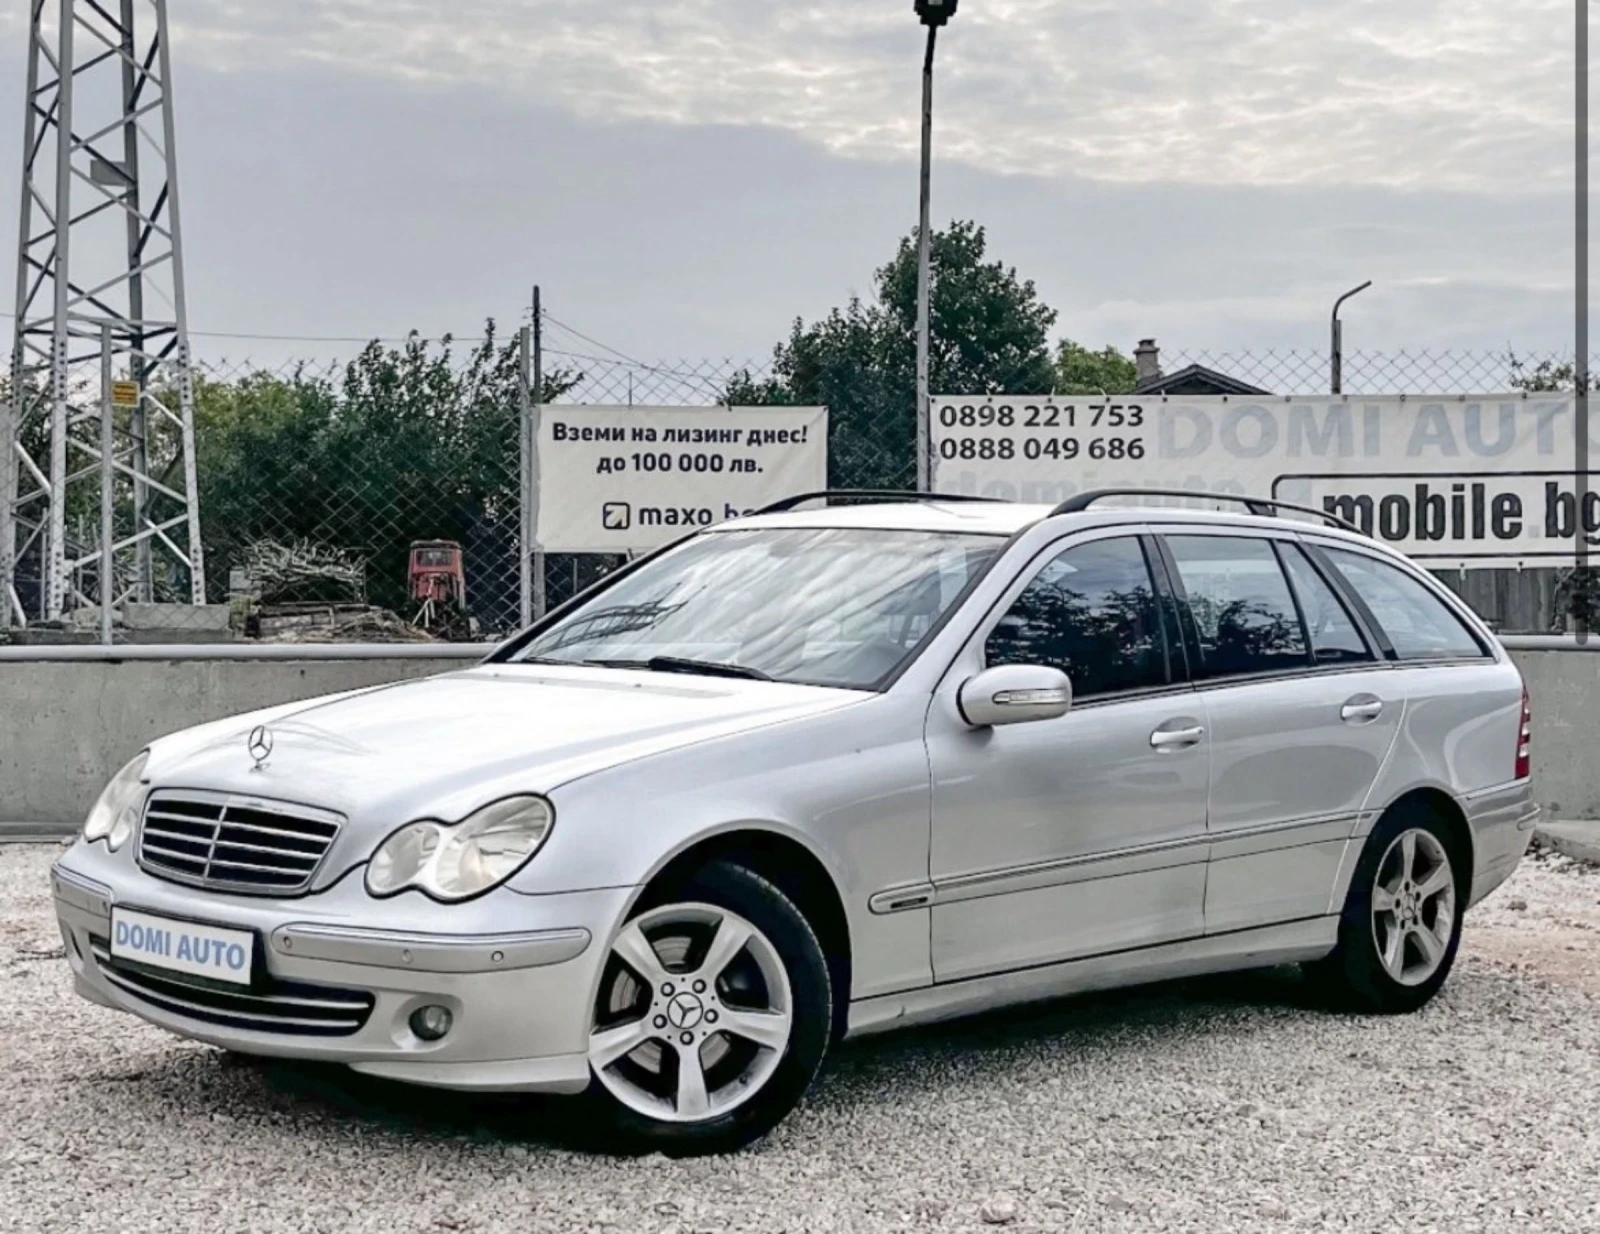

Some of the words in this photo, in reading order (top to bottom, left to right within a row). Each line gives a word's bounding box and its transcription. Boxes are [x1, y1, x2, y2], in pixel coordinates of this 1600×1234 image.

[939, 404, 1015, 428] 0898
[1023, 404, 1076, 427] 221
[1088, 404, 1144, 428] 753
[552, 422, 625, 442] Вземи
[631, 427, 657, 443] на
[662, 426, 743, 444] лизинг
[746, 425, 808, 447] днес!
[1157, 403, 1381, 460] DOMI
[939, 437, 1016, 460] 0888
[1023, 437, 1080, 460] 049
[1088, 437, 1146, 460] 686
[596, 456, 626, 474] до
[631, 452, 672, 472] 100
[678, 453, 724, 473] 000
[728, 457, 764, 474] лв.
[116, 919, 171, 957] DOMI
[176, 934, 246, 971] AUTO
